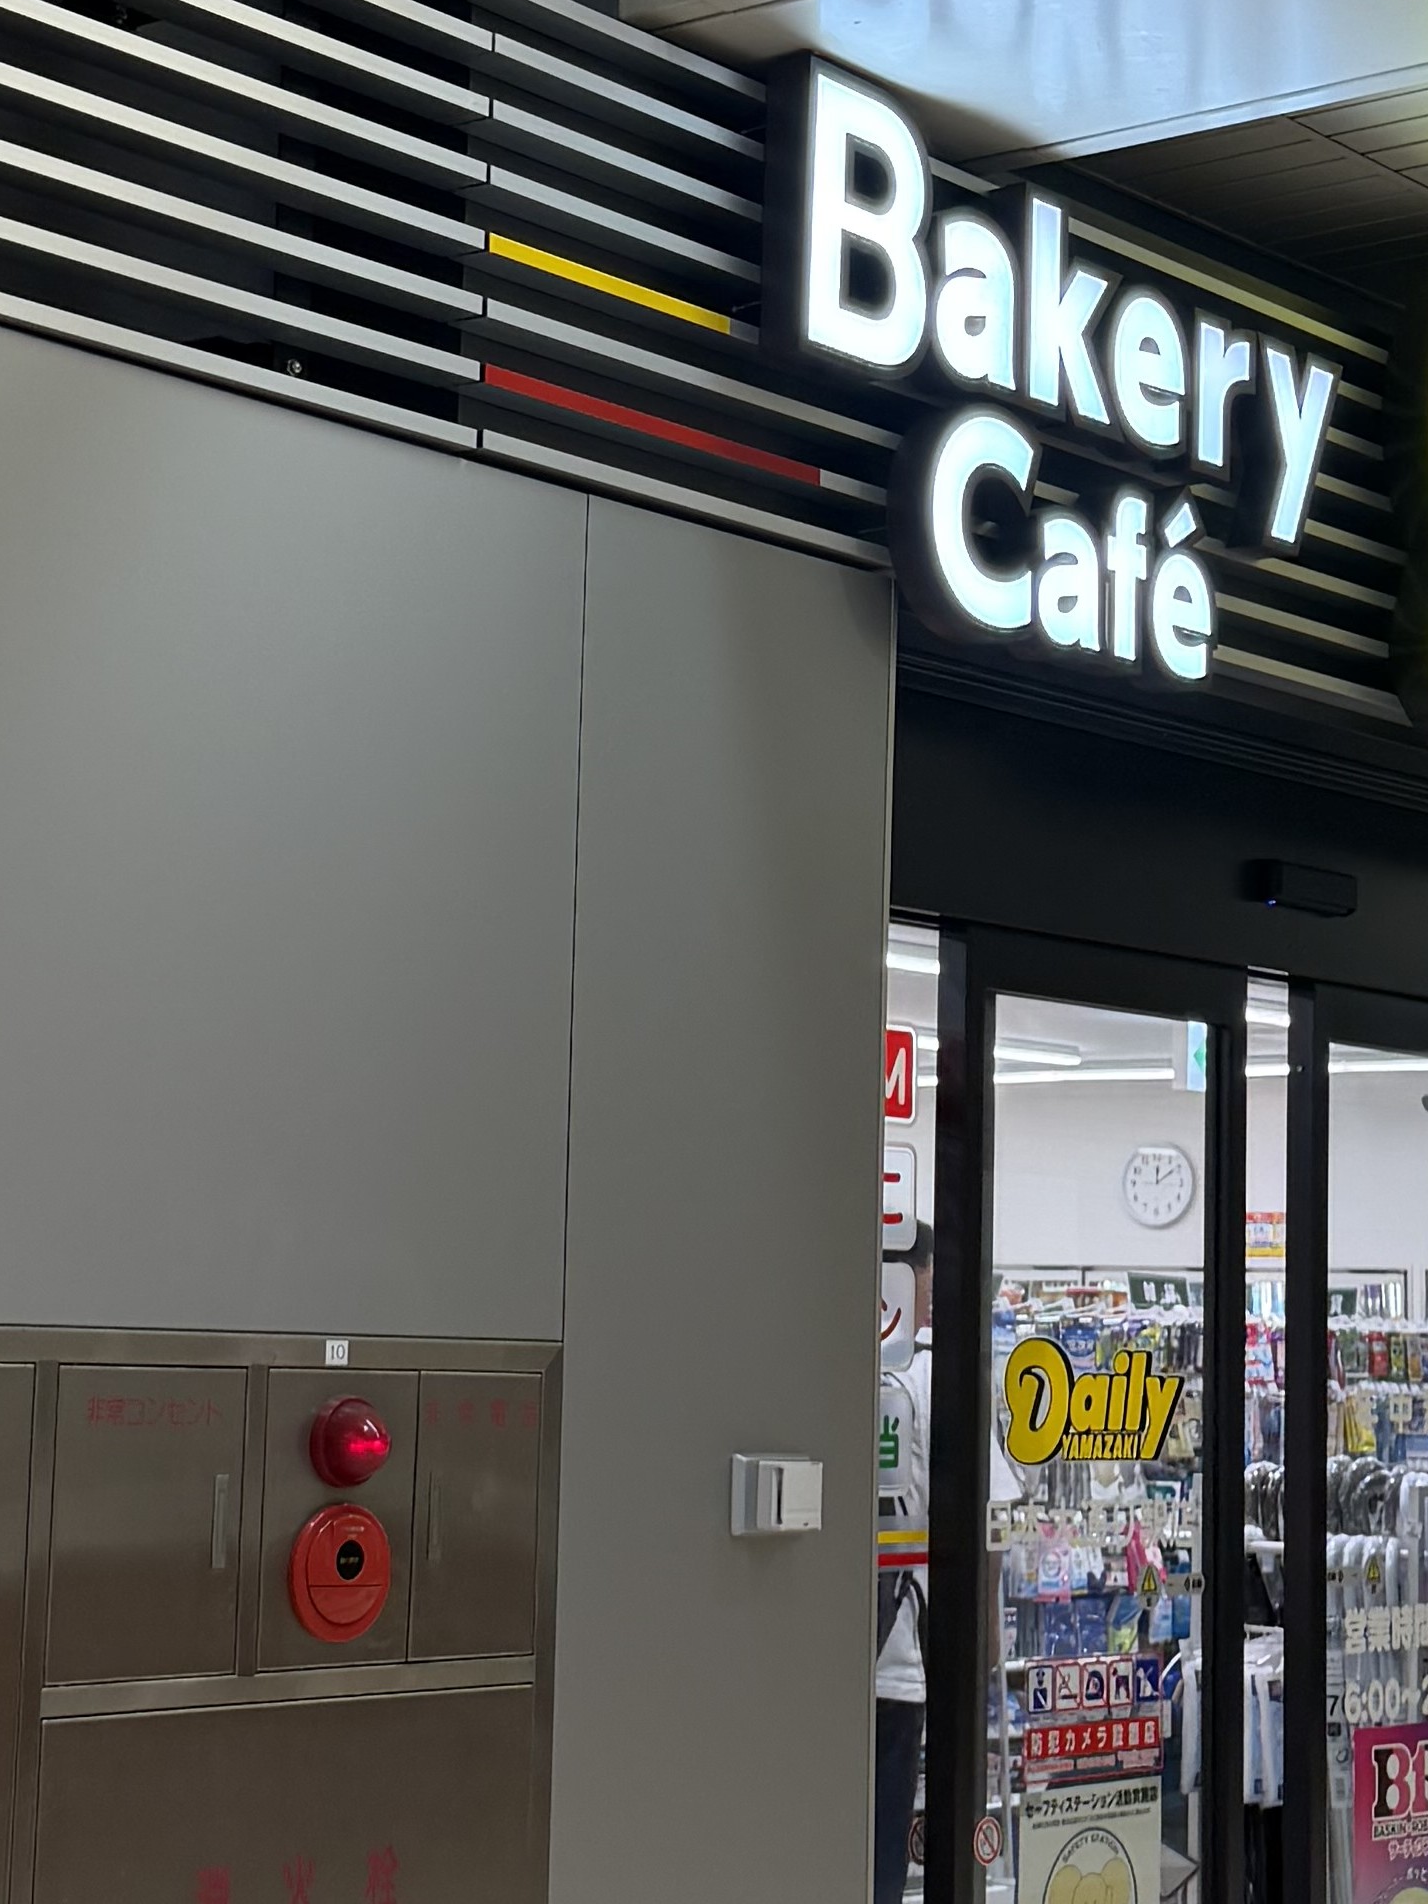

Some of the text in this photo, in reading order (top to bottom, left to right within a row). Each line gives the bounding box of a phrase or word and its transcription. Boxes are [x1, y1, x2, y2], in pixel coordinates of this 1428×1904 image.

[805, 72, 1336, 544] Bakery
[931, 414, 1214, 683] Café
[329, 1343, 346, 1361] 10
[1005, 1338, 1185, 1465] Daily
[1061, 1432, 1140, 1462] YAMAZAKI
